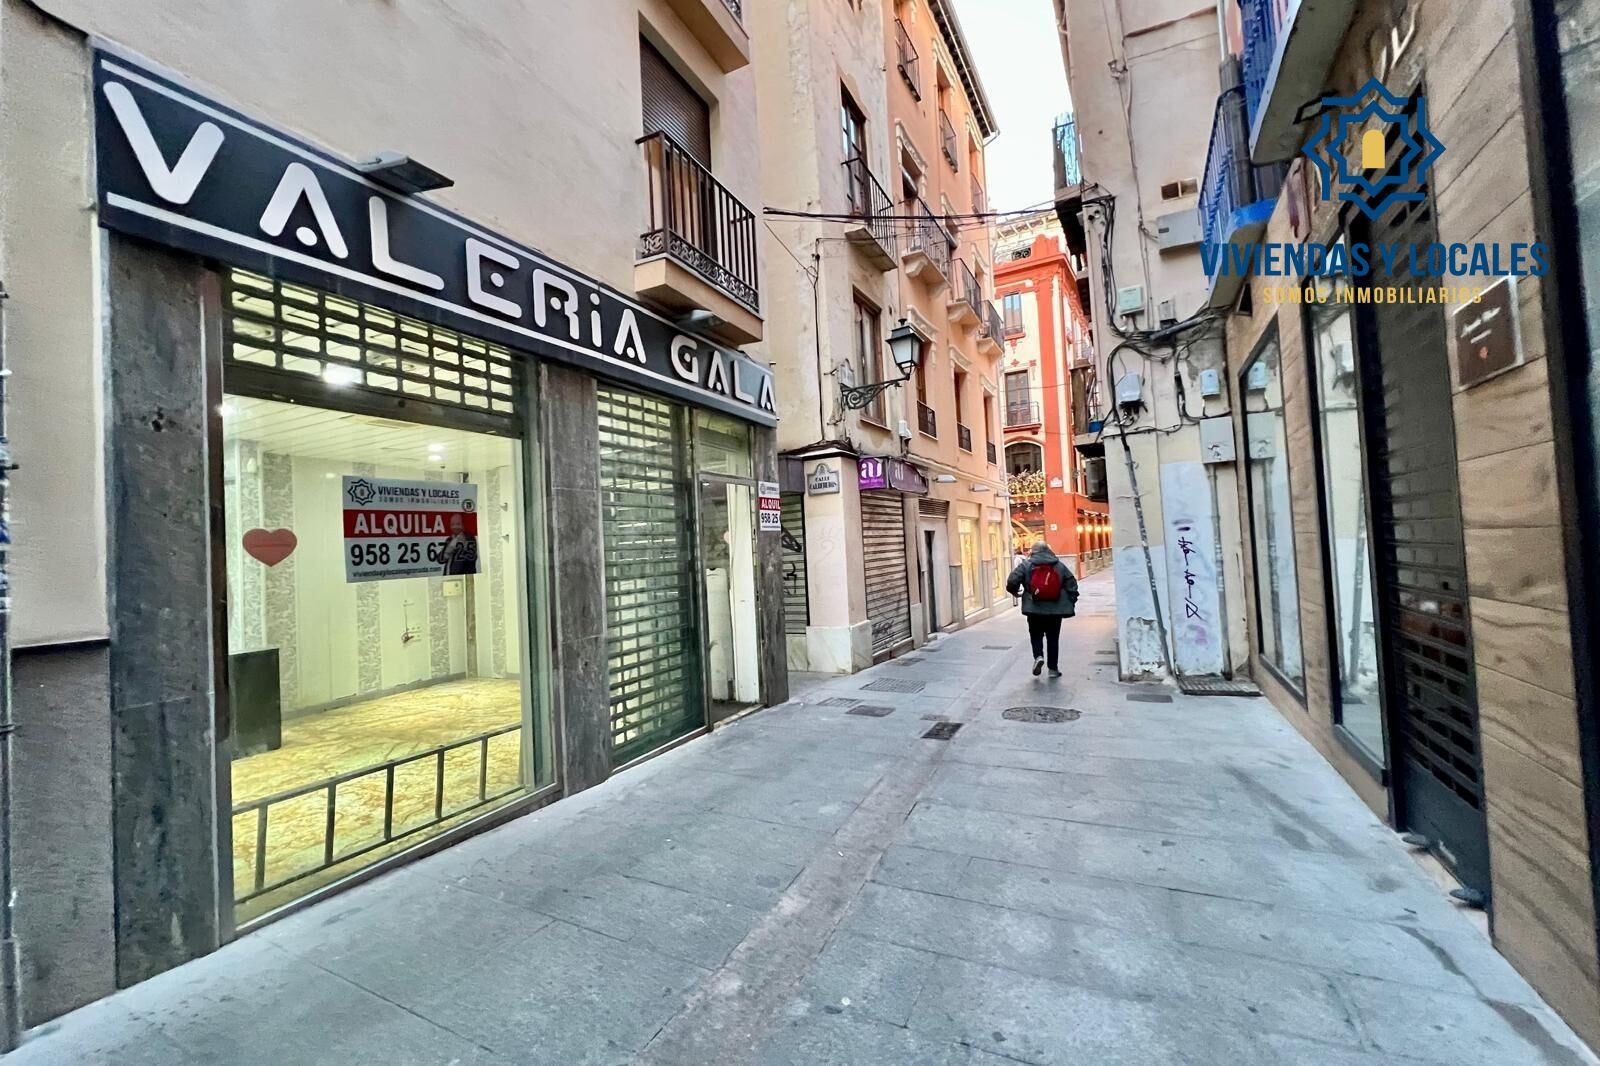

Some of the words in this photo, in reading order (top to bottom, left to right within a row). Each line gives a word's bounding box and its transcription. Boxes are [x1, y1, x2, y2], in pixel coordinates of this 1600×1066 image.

[671, 334, 777, 413] GALA
[377, 485, 419, 497] VIVIENDAS
[421, 488, 427, 498] Y
[428, 489, 460, 499] LOCALES
[354, 512, 446, 535] ALQUILA
[772, 513, 779, 523] 25
[350, 543, 391, 567] 958
[397, 542, 421, 564] 25
